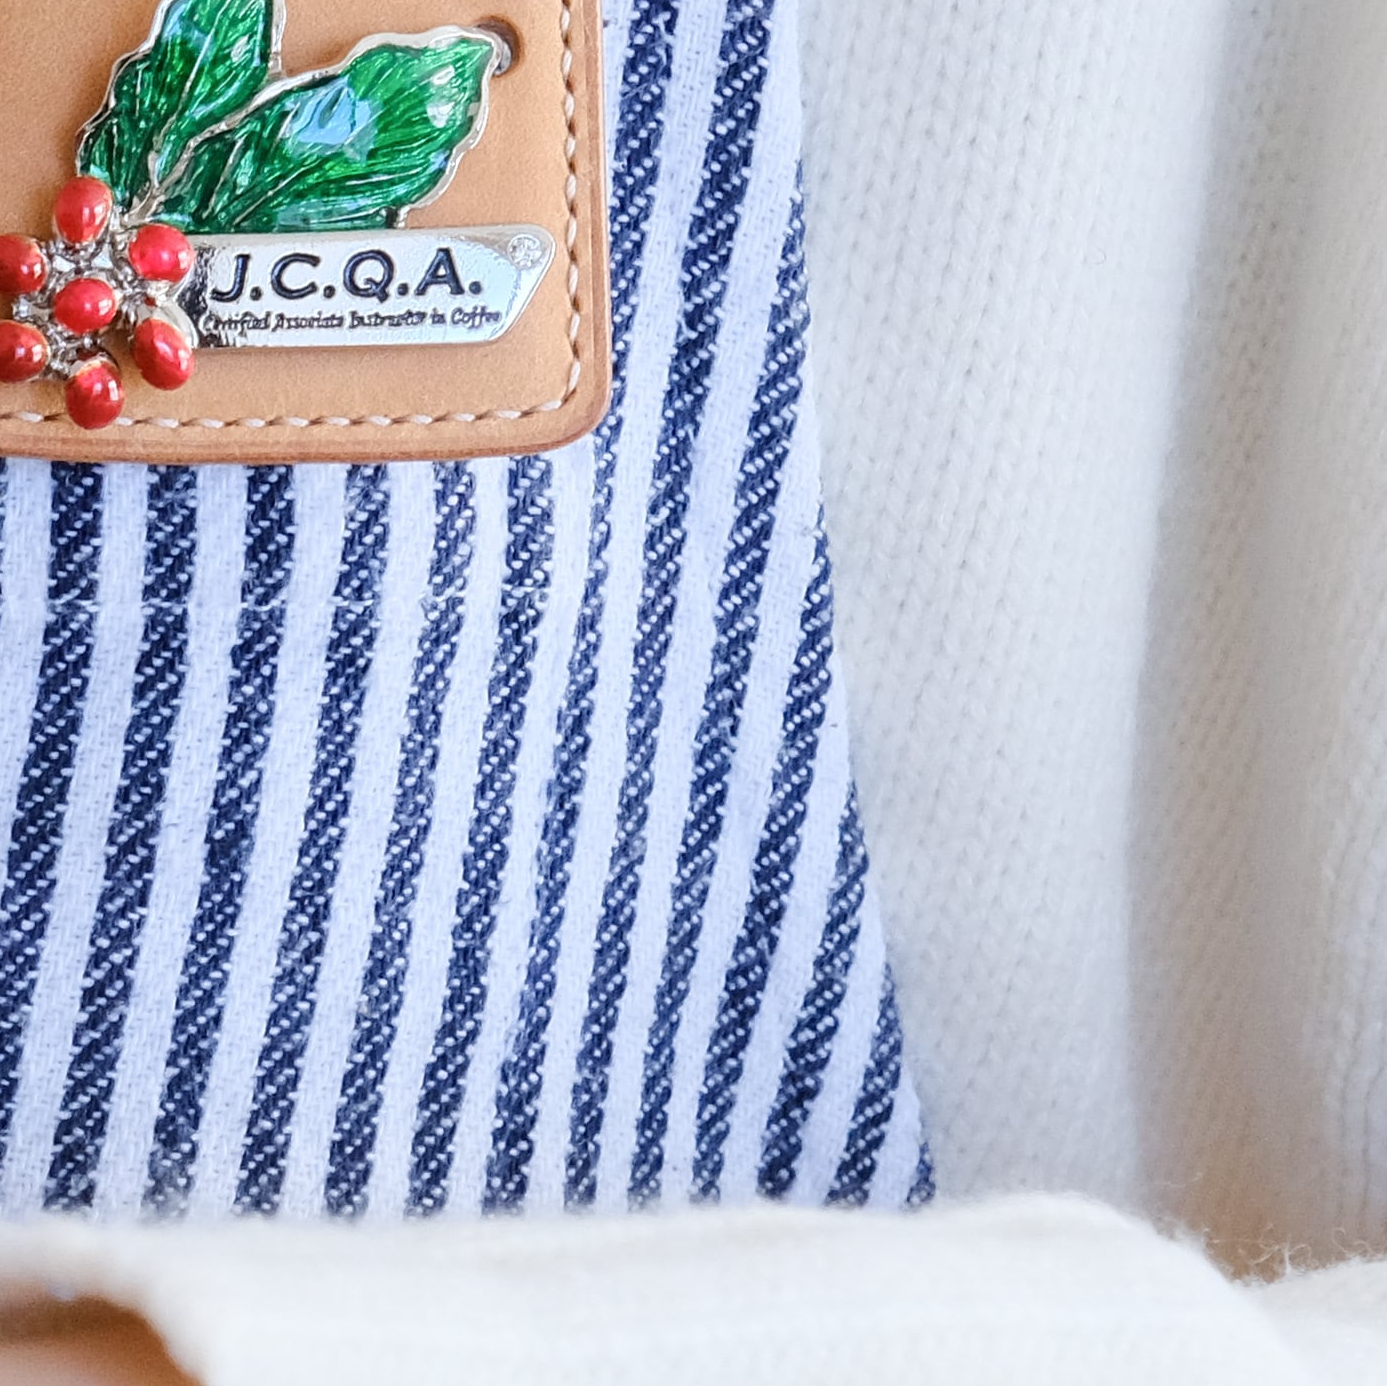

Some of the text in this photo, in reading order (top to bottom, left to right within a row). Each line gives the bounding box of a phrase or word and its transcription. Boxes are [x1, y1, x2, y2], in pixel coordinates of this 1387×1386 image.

[210, 247, 482, 302] J.C.Q.A.
[430, 308, 446, 325] in
[451, 306, 501, 330] Coffee
